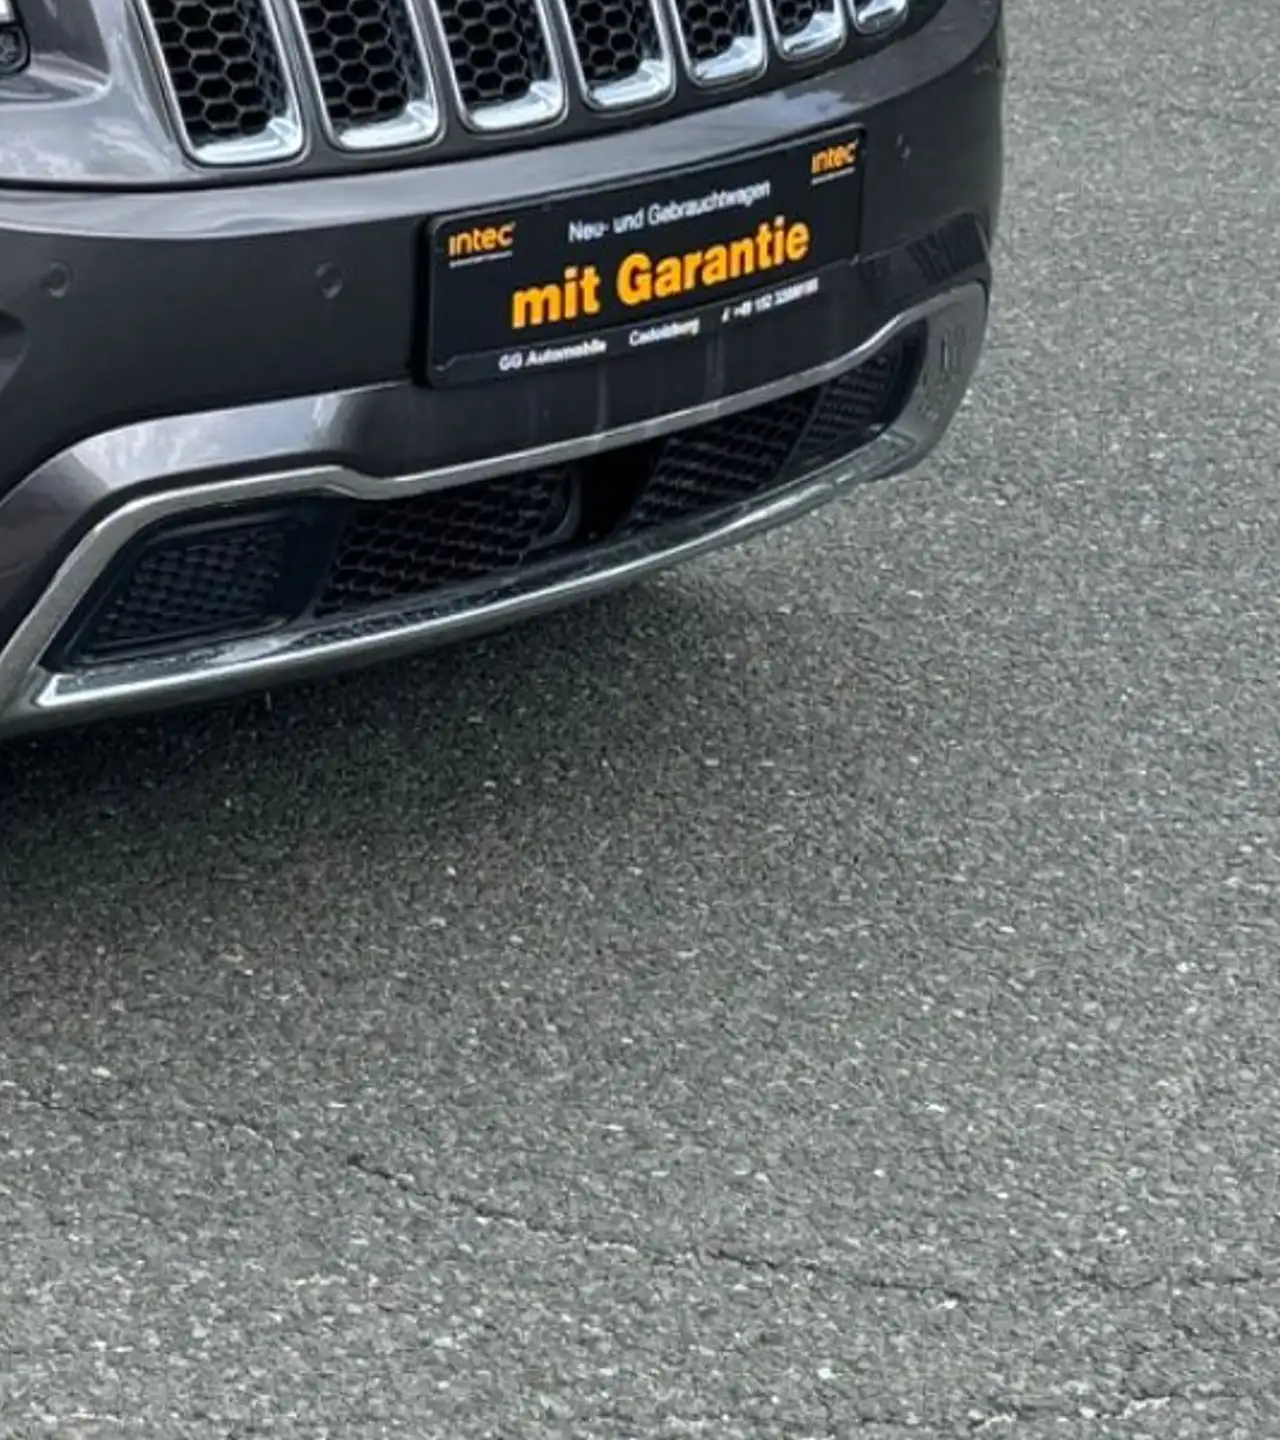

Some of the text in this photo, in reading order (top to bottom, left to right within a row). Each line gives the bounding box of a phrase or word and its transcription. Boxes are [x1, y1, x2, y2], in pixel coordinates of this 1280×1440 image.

[613, 207, 644, 234] und
[648, 180, 770, 226] Gebrauchtwagen
[511, 215, 811, 329] mit Garantie
